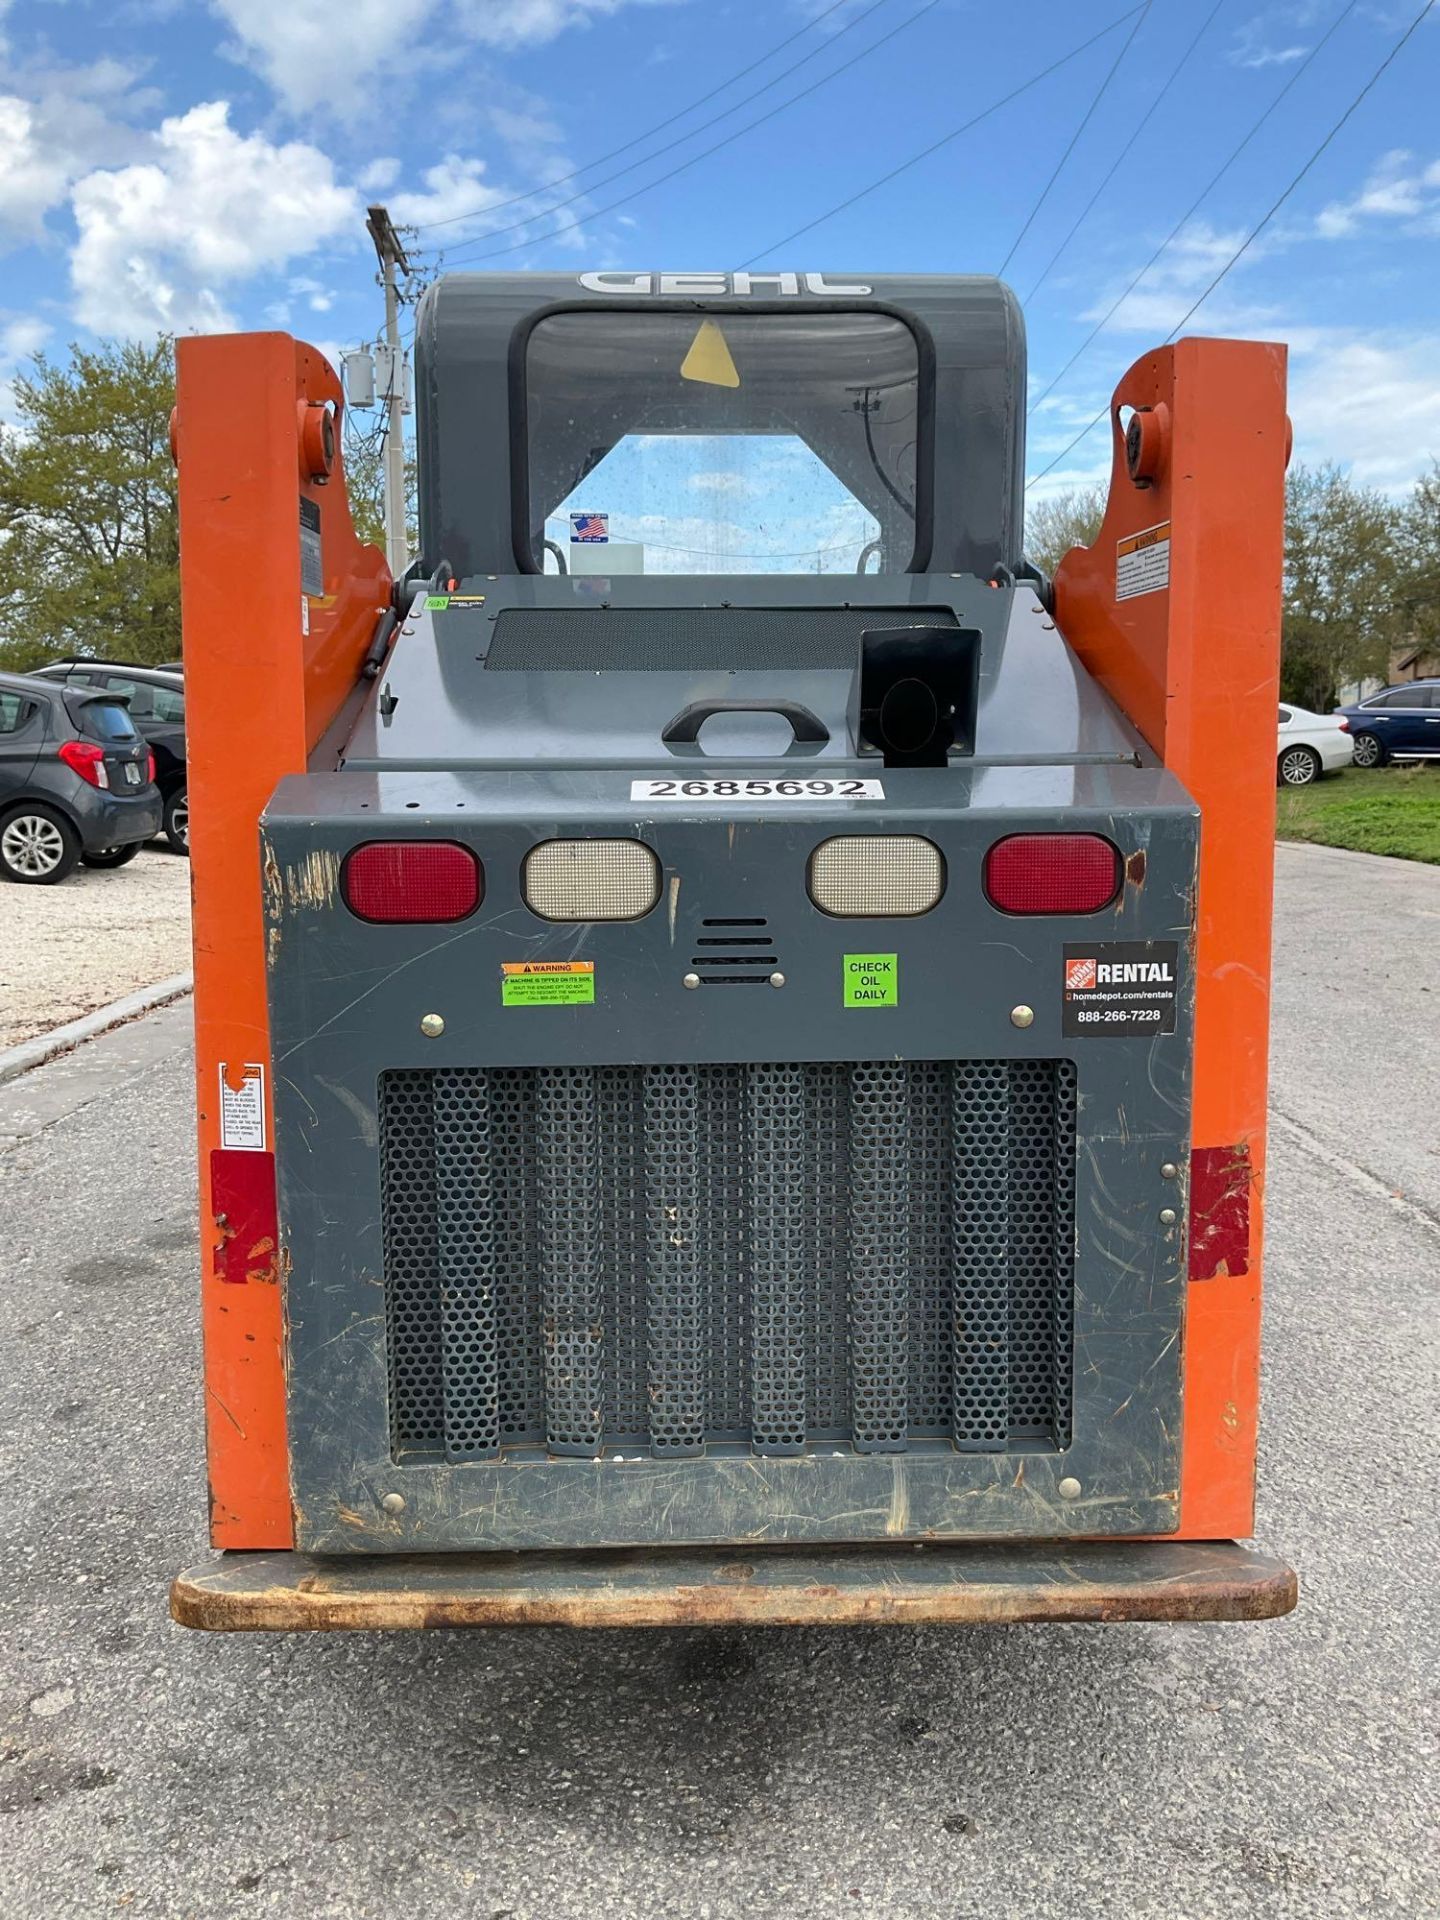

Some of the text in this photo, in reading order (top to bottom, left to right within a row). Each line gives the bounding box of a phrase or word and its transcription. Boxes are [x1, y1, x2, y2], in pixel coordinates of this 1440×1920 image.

[578, 272, 872, 295] GEHL
[649, 781, 867, 796] 2685692
[850, 962, 891, 972] CHECK
[1097, 963, 1174, 983] RENTAL
[1066, 960, 1096, 987] HOME
[861, 976, 880, 986] OIL
[854, 990, 887, 999] DAILY
[1073, 990, 1173, 1002] homedepot.com/rentals
[1078, 1010, 1161, 1022] 888-266-7228
